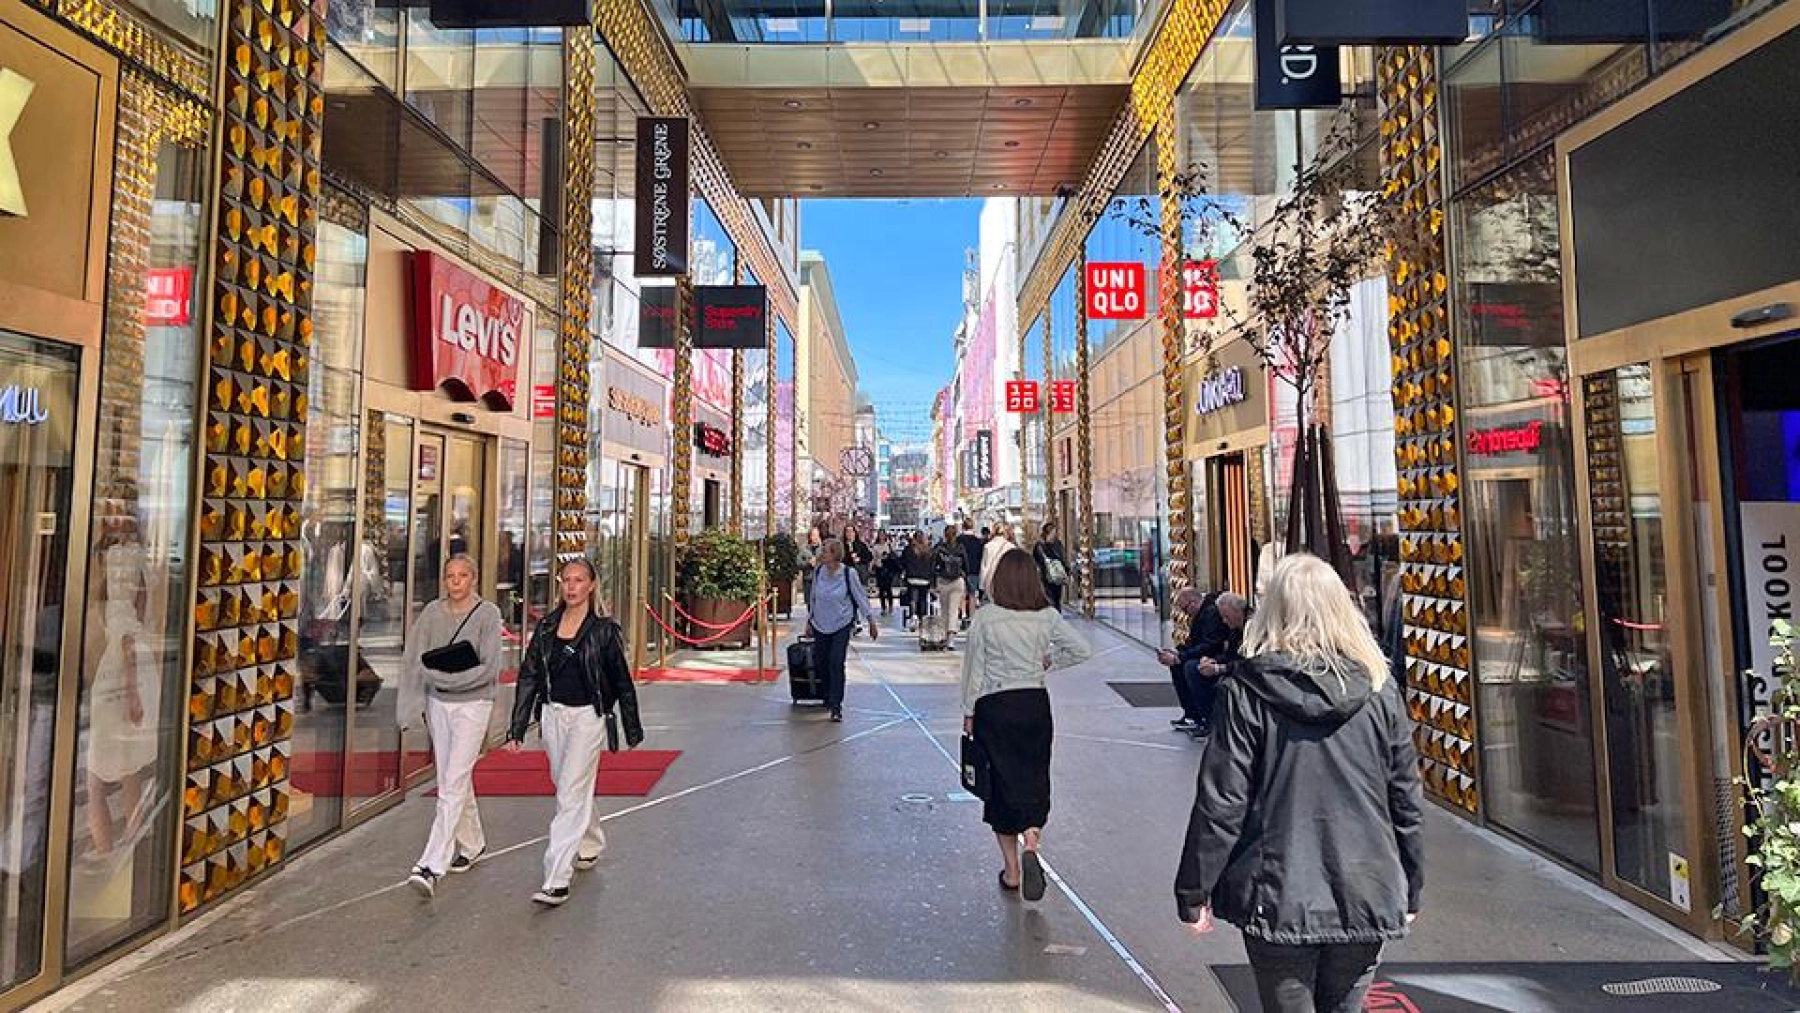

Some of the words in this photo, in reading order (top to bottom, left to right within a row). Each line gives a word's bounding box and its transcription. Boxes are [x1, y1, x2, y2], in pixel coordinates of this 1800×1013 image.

[654, 123, 672, 179] GRENE
[653, 183, 672, 270] SØSTRENE
[1092, 269, 1135, 288] UNI
[1093, 292, 1139, 315] QLO
